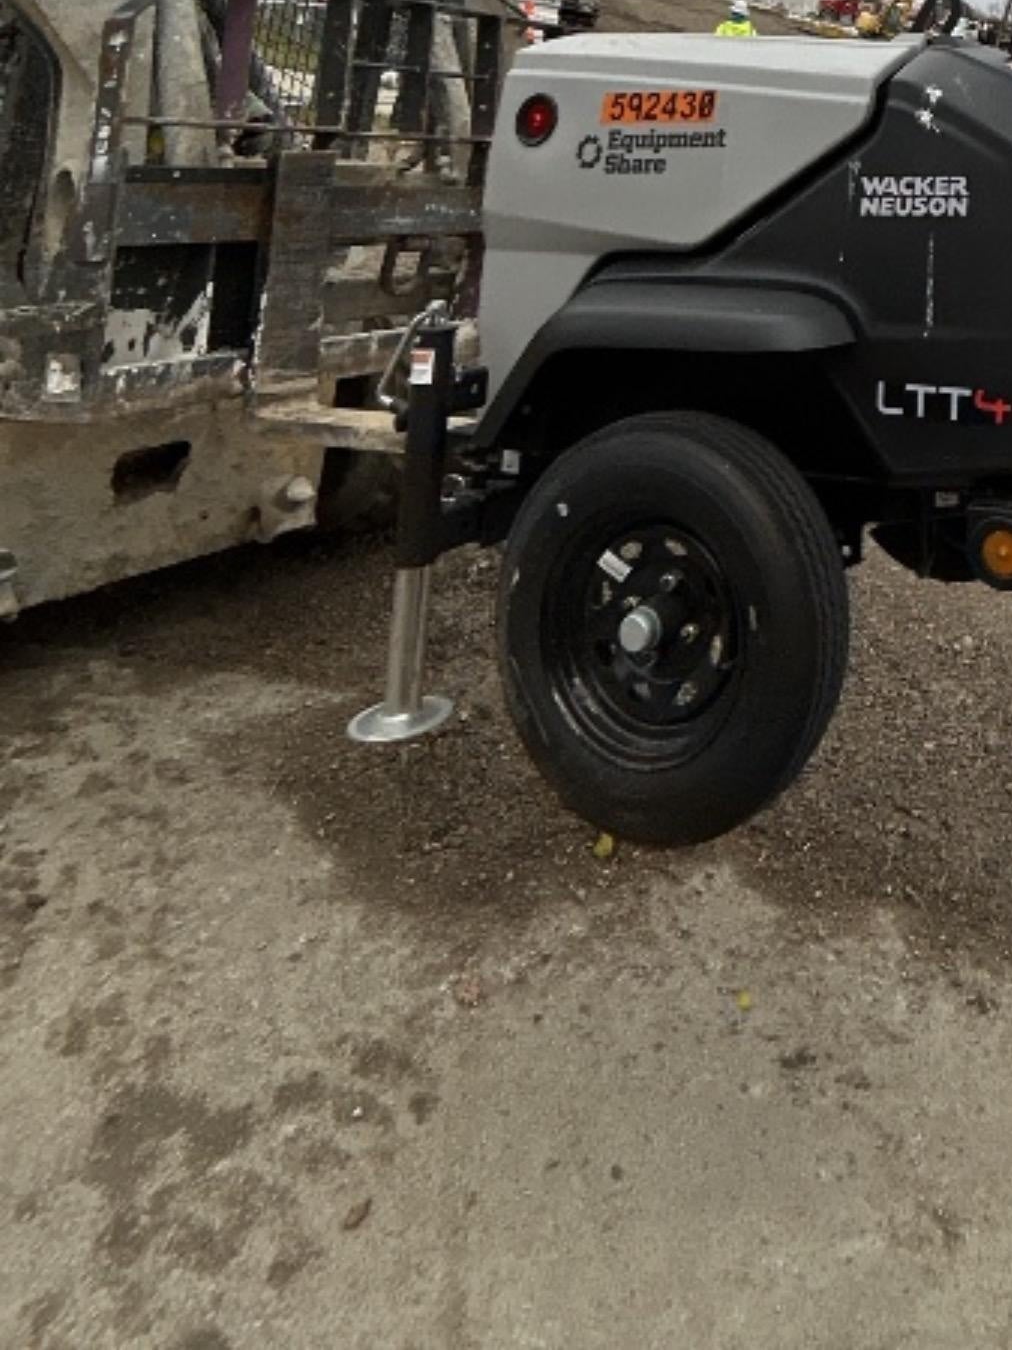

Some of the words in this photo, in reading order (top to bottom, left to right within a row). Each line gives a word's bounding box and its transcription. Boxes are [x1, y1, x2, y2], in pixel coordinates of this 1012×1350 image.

[610, 89, 717, 121] 592430
[608, 128, 727, 154] Equipment
[604, 153, 667, 175] Share
[860, 176, 969, 196] WACKER
[860, 197, 968, 217] NEUSON
[875, 380, 1012, 425] LTT4
